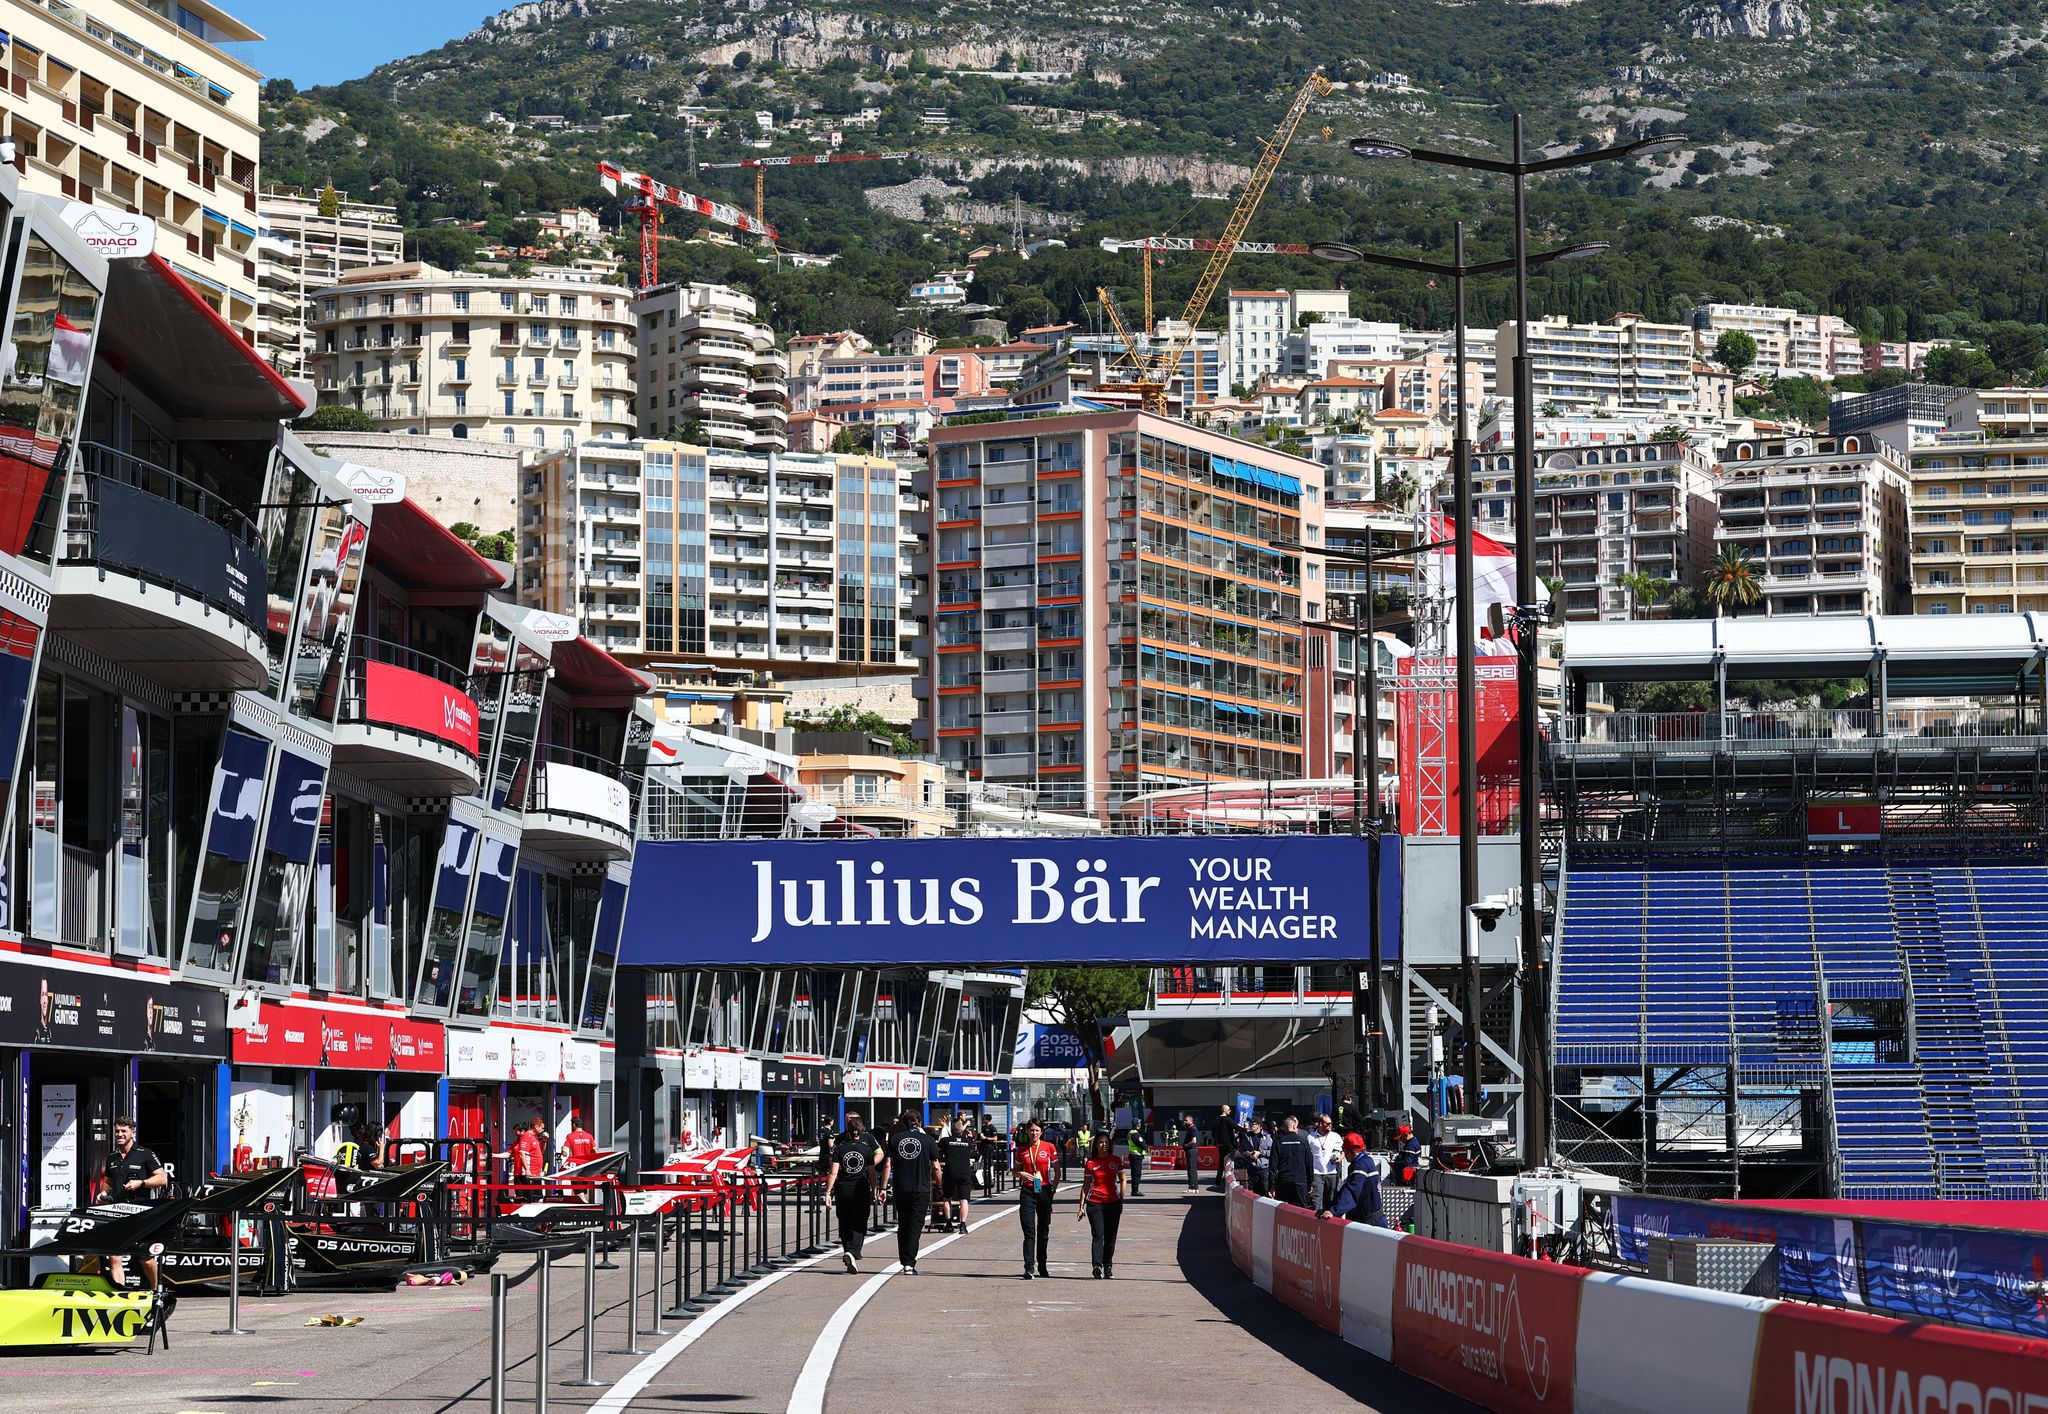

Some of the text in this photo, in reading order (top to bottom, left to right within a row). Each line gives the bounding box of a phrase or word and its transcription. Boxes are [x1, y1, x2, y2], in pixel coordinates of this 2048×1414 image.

[84, 238, 137, 246] ONACO
[1838, 811, 1851, 829] L
[1188, 857, 1273, 884] YOUR
[751, 858, 1161, 944] Julius Bär
[1188, 886, 1310, 911] WEALTH
[1190, 915, 1338, 940] MANAGER
[54, 1005, 79, 1026] GÜNTHER
[153, 1004, 164, 1034] 77
[163, 1019, 183, 1035] BARNARD
[325, 1027, 334, 1051] 21
[1040, 1034, 1080, 1045] 2026
[54, 1112, 64, 1127] 7
[668, 1157, 681, 1165] 23
[203, 1184, 215, 1196] 7
[360, 1176, 379, 1187] 77
[66, 1217, 96, 1233] 28
[317, 1239, 338, 1250] DS
[52, 1307, 142, 1337] TWG
